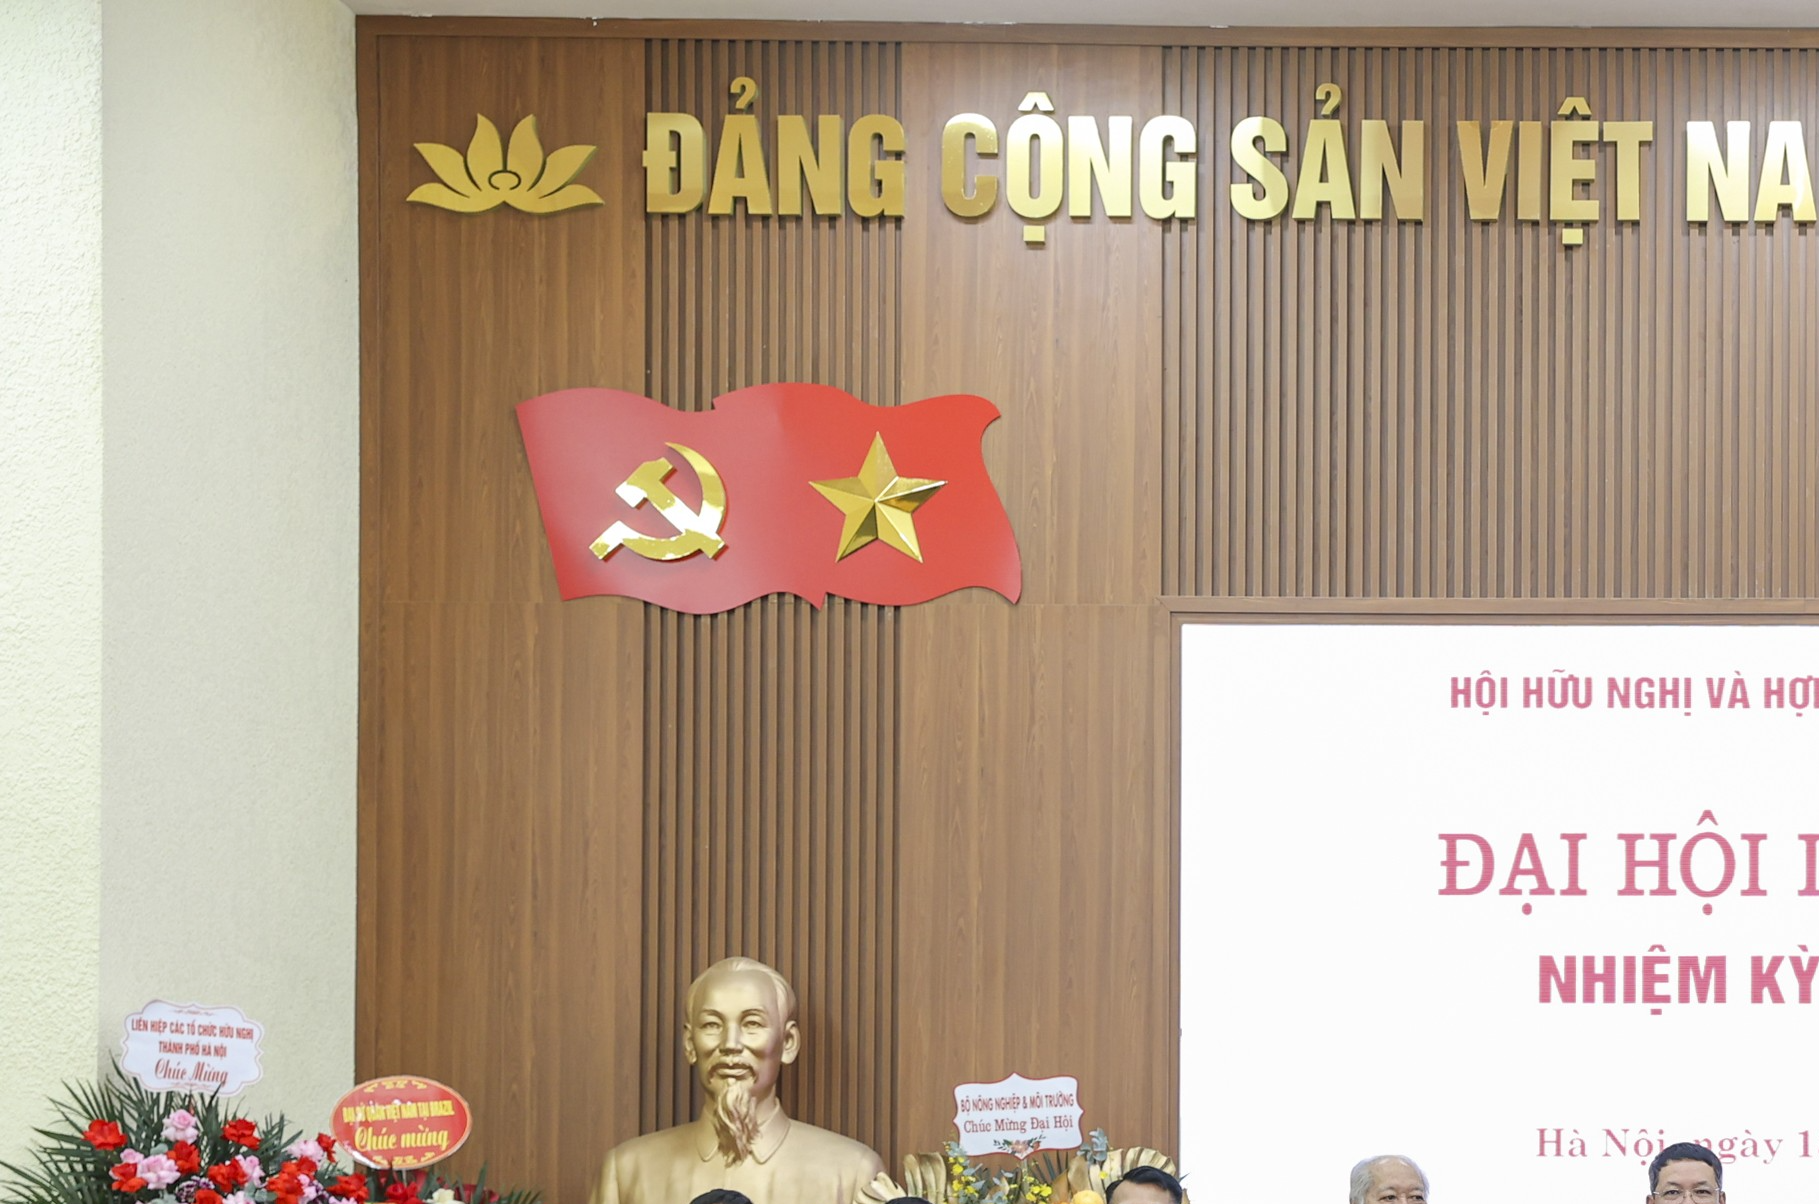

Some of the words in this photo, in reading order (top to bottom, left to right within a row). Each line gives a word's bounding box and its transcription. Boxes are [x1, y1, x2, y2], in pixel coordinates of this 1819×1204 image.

[643, 76, 905, 218] ĐẢNG
[942, 92, 1197, 246] CỘNG
[1230, 82, 1424, 222] SẢN
[1456, 97, 1652, 245] VIỆT
[1450, 671, 1509, 716] HỘI
[1523, 669, 1593, 710] HỮU
[1607, 677, 1693, 716] NGHỊ
[1706, 671, 1750, 709] VÀ
[1438, 833, 1587, 915] ĐẠI
[1617, 810, 1768, 915] HỘI
[1538, 944, 1727, 1015] NHIỆM
[154, 1058, 187, 1080] Chúc
[960, 1095, 971, 1116] BỘ
[972, 1094, 994, 1112] NÔNG
[995, 1093, 1021, 1113] NGHIỆP
[1022, 1096, 1029, 1109] &
[1029, 1091, 1044, 1110] MÔI
[355, 1127, 397, 1152] Chúc
[401, 1124, 449, 1151] mừng
[963, 1119, 992, 1134] Chúc
[995, 1118, 1027, 1134] Mừng
[1030, 1116, 1050, 1133] Đại
[1053, 1115, 1073, 1132] Hội
[1536, 1128, 1588, 1157] Hà
